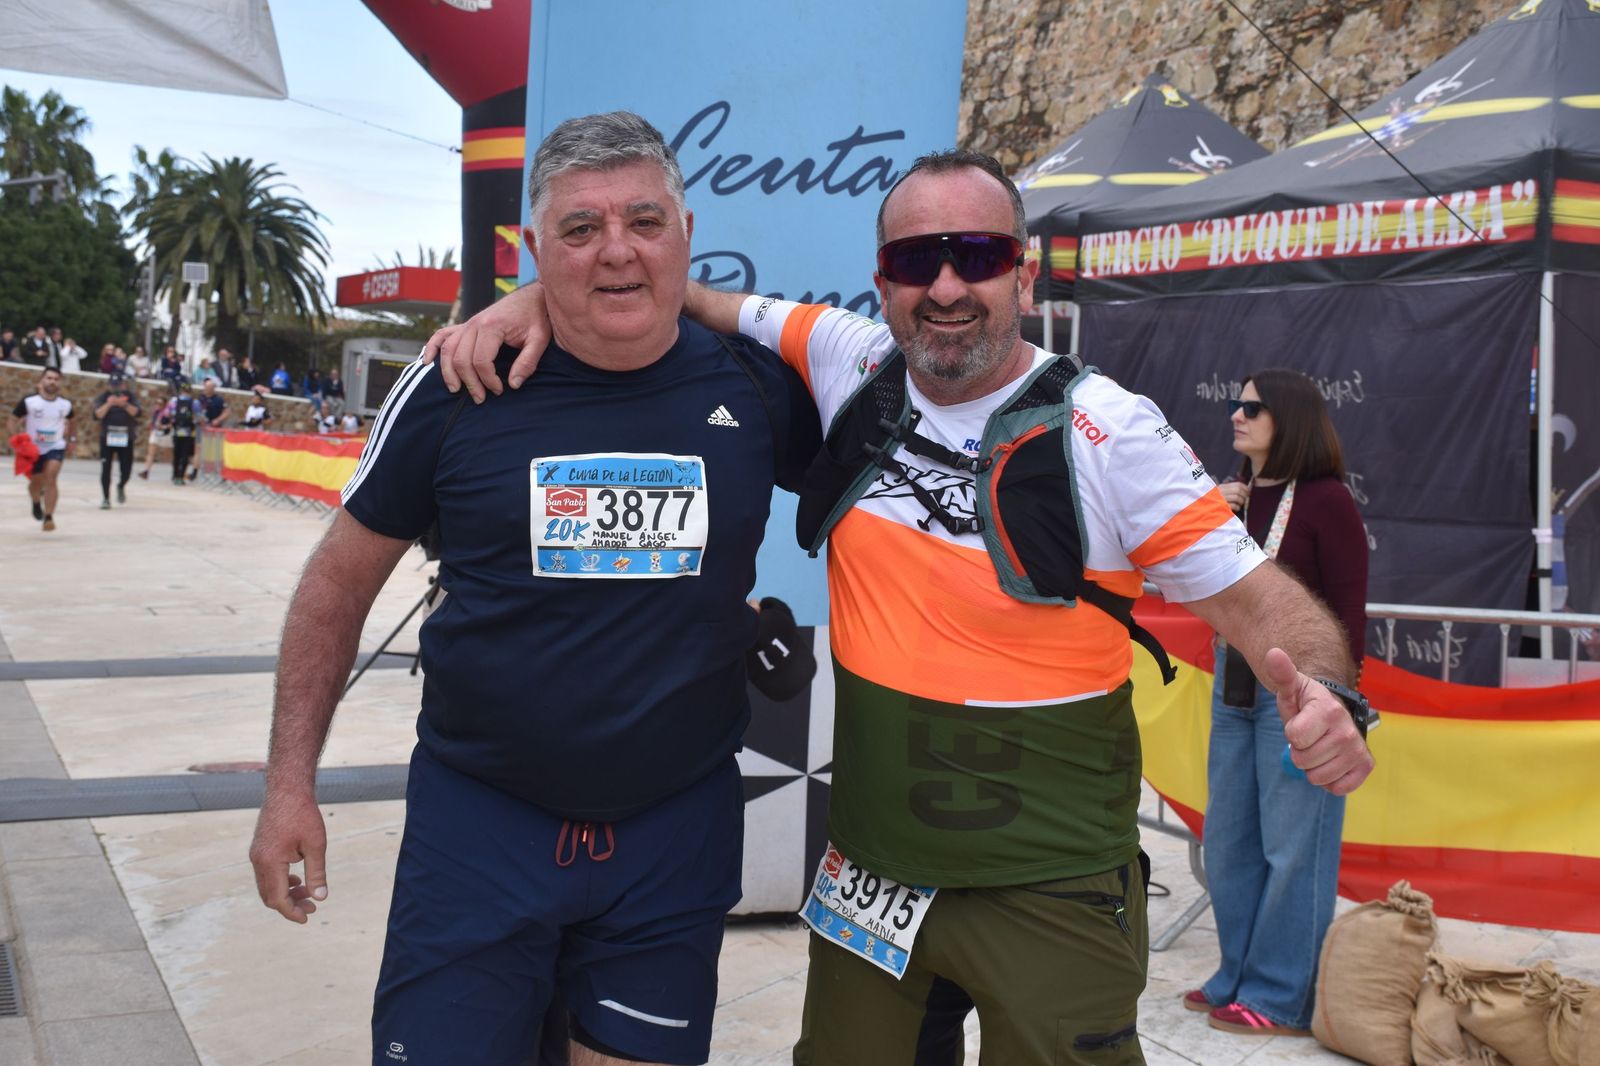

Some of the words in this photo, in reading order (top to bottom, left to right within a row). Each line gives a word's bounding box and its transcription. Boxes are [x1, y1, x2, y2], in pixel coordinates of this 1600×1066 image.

[1081, 223, 1182, 278] TERCIO
[1333, 201, 1385, 255] DE
[370, 271, 400, 299] CEPSA
[707, 417, 740, 428] adidas
[1072, 409, 1109, 446] strol
[546, 497, 563, 507] San
[563, 496, 587, 507] Pablo
[596, 489, 695, 532] 3877
[544, 518, 591, 541] 20K
[593, 531, 633, 541] MANUEL
[592, 539, 627, 548] AMADOR
[639, 539, 667, 548] GAGO
[840, 863, 920, 931] 3915
